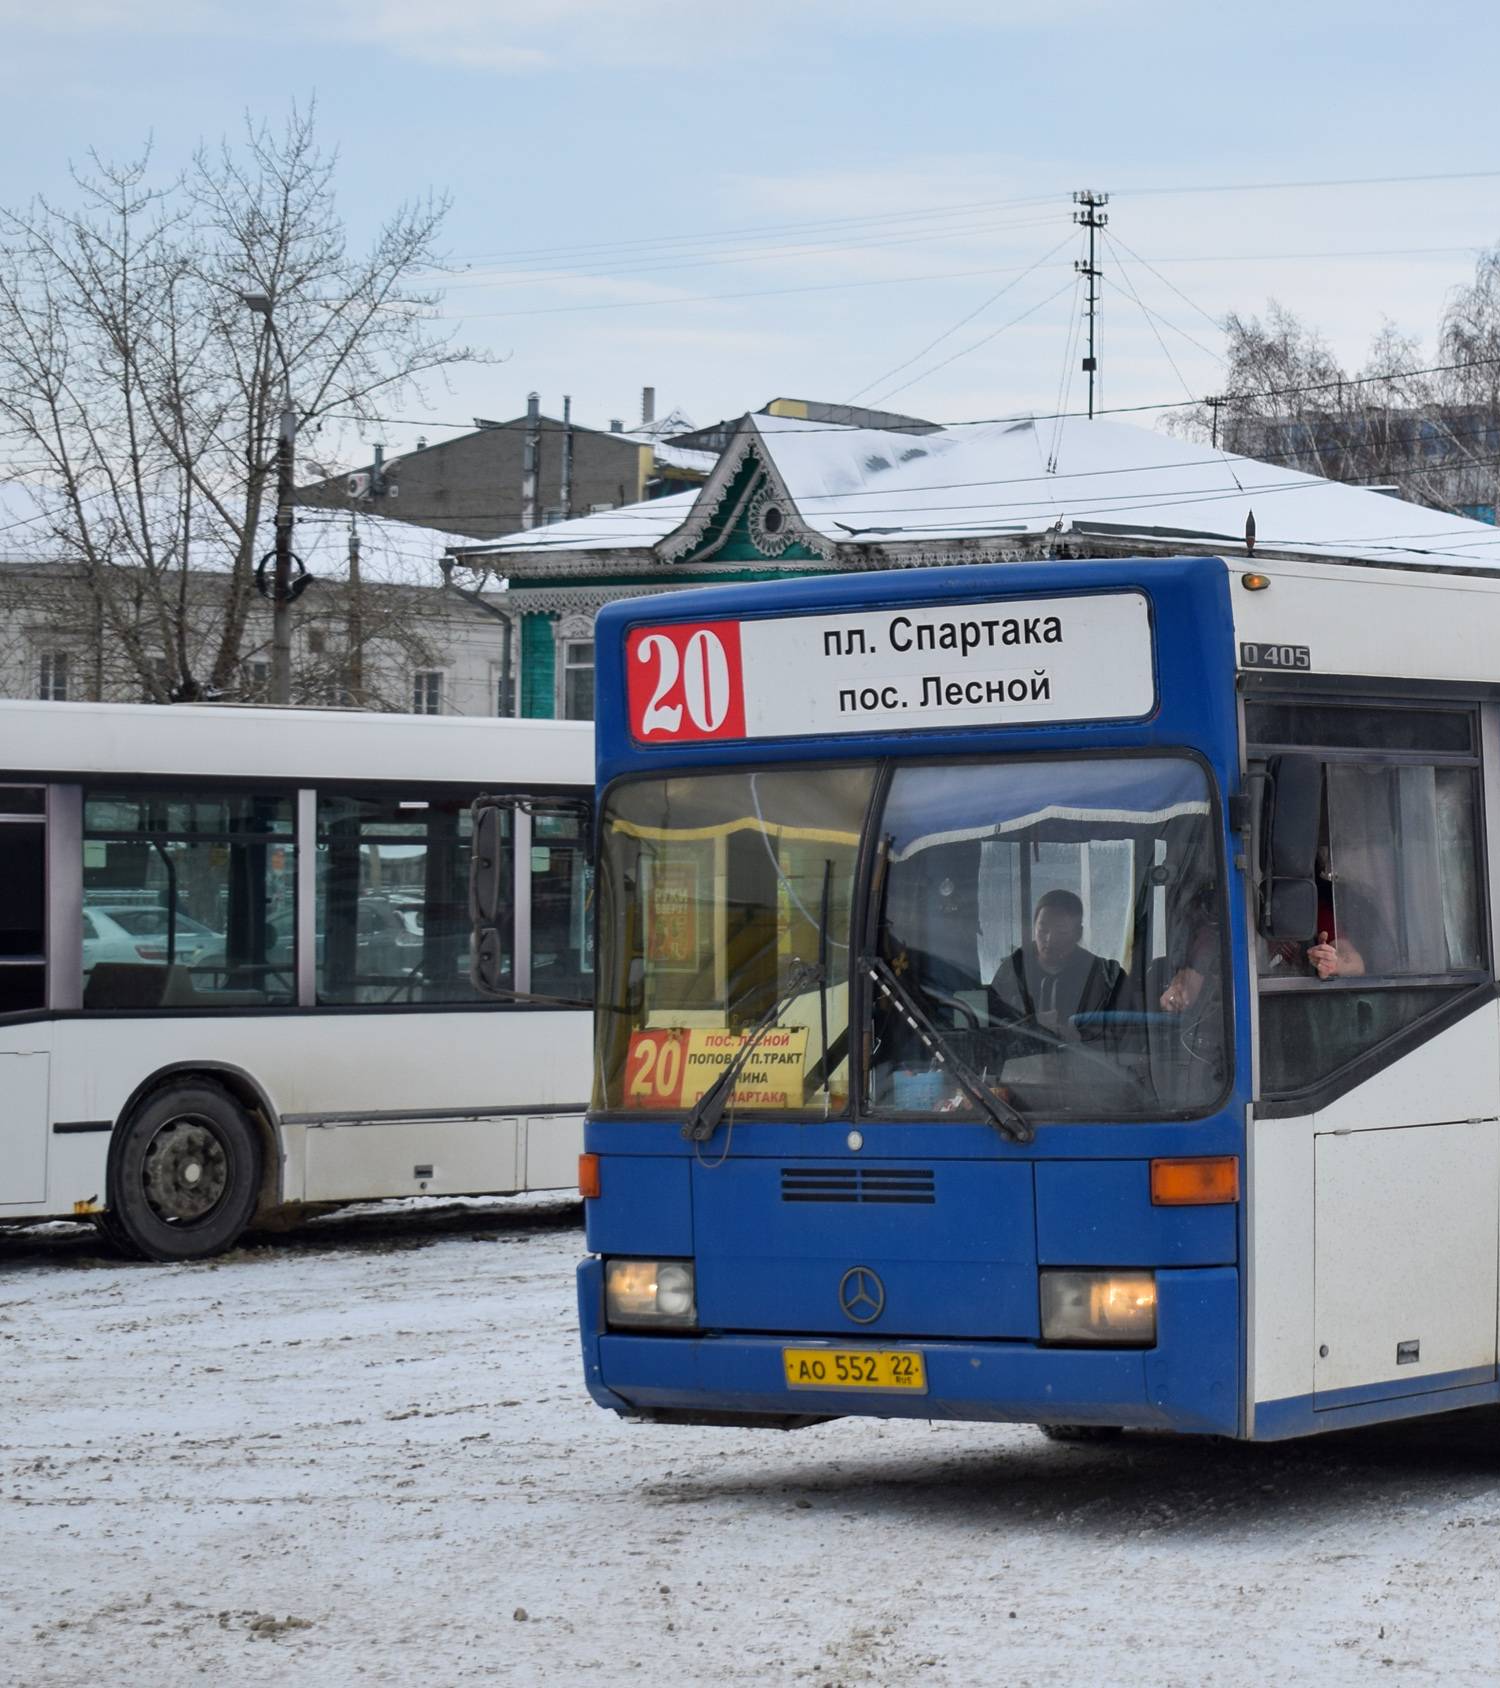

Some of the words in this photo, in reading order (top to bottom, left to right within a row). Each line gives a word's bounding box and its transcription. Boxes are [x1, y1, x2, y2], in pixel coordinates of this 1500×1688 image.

[823, 625, 877, 657] пл.
[889, 613, 1064, 657] Спартака
[1263, 646, 1310, 668] 405
[635, 628, 731, 736] 20
[838, 678, 907, 713] пос.
[919, 669, 1052, 709] Лесной
[704, 1034, 735, 1048] ПОС.
[738, 1033, 791, 1047] ЛСНОЙ
[630, 1038, 682, 1098] 20
[688, 1052, 737, 1065] ПОПОВ
[834, 1354, 879, 1381] 552
[890, 1355, 915, 1376] 22
